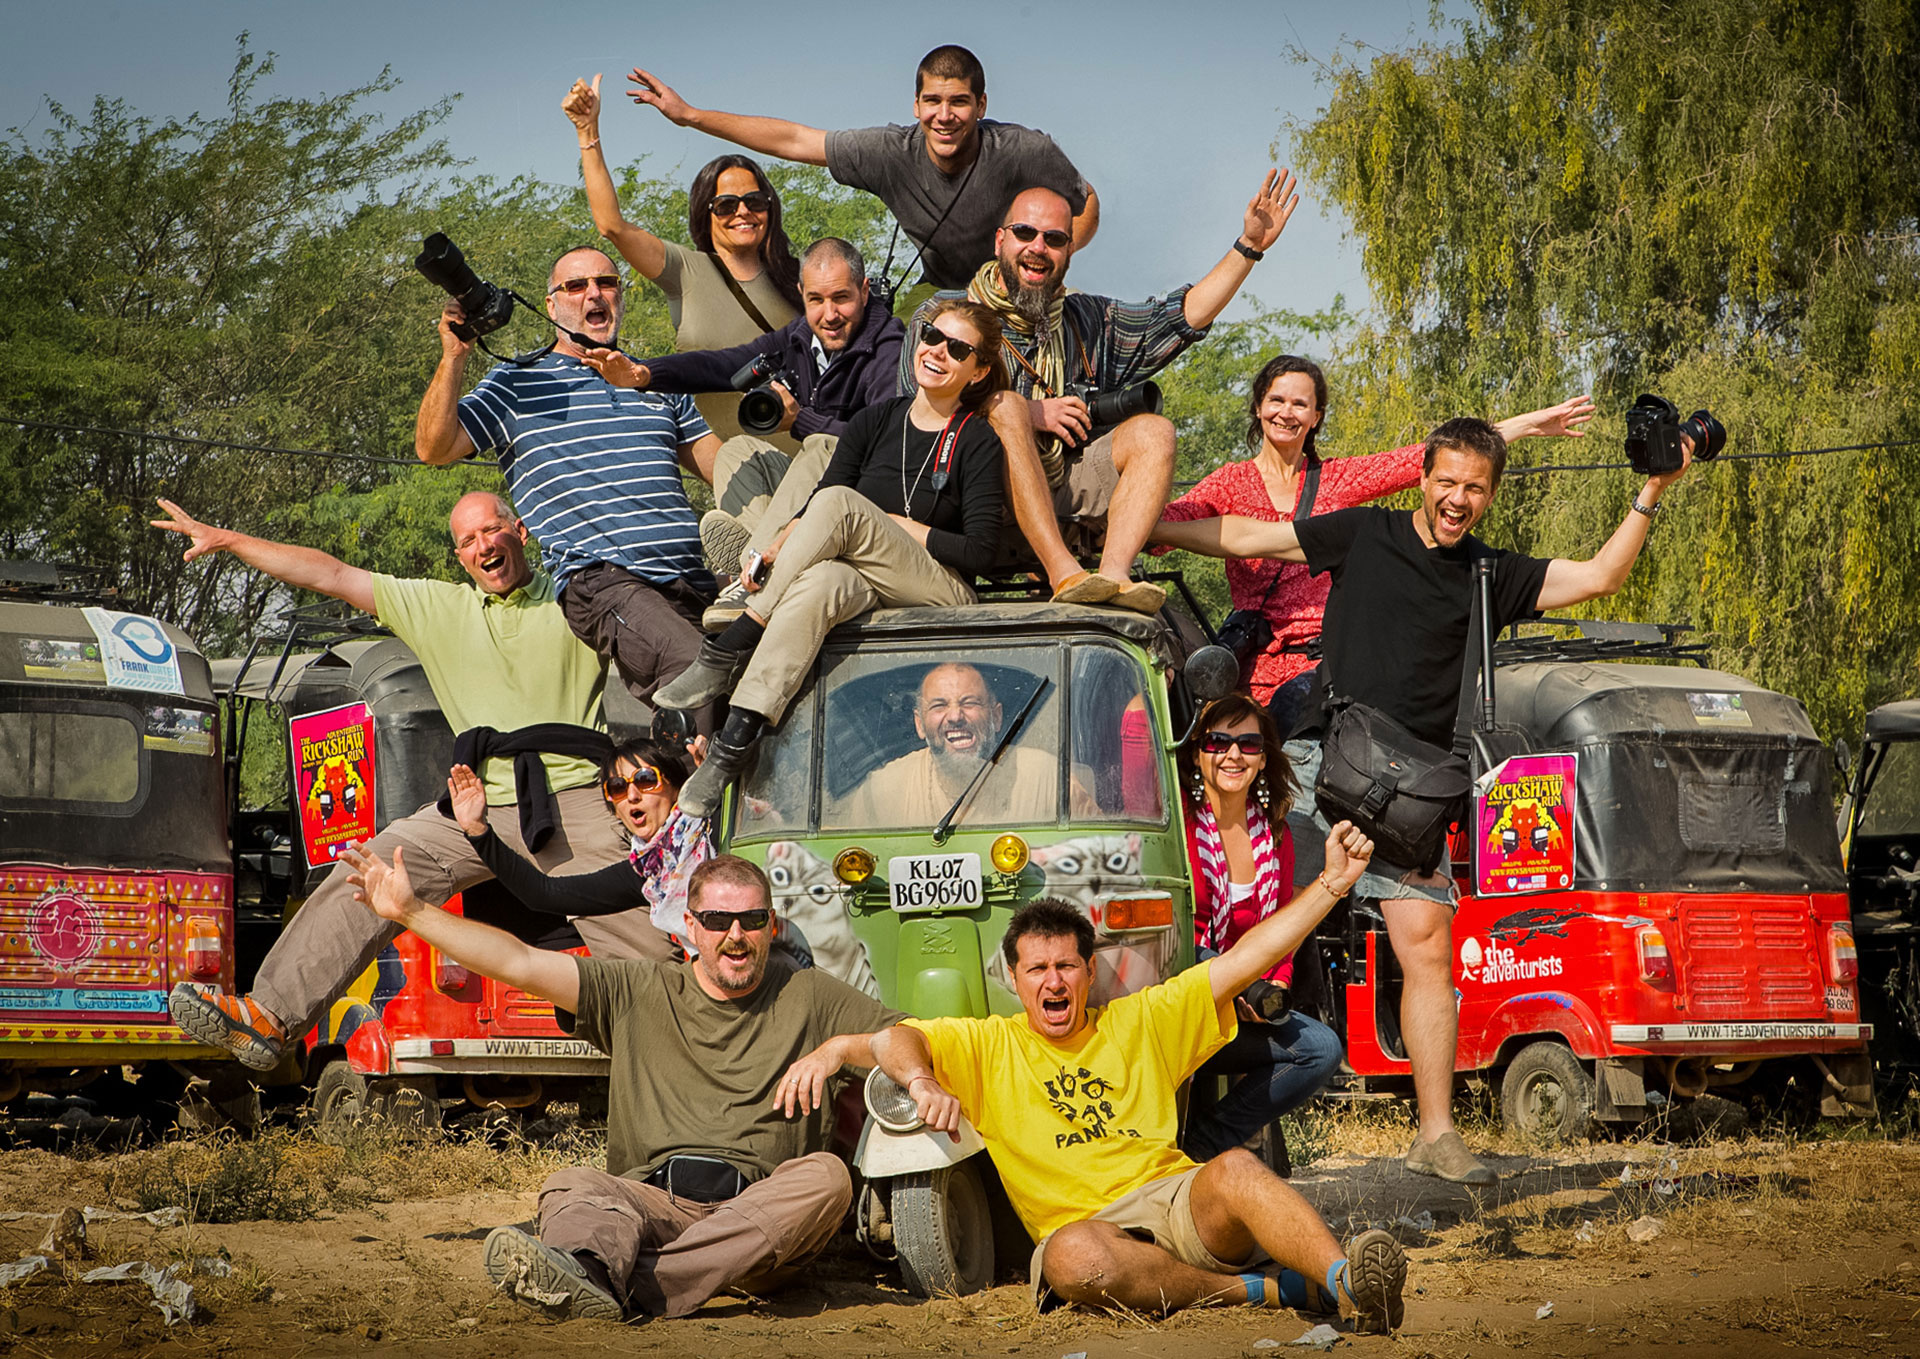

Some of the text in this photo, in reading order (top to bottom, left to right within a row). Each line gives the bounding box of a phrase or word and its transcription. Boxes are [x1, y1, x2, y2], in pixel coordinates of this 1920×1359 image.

[940, 431, 956, 463] Canon
[302, 731, 365, 763] RICKSHAW
[347, 748, 365, 763] RUN
[1540, 796, 1562, 807] RUN
[1484, 938, 1516, 967] the
[1482, 955, 1563, 985] adventurists
[74, 989, 153, 1009] CAMELS
[1687, 1025, 1836, 1039] WWW.THEADVENTURISTS.COM
[485, 1040, 602, 1056] WWW.THEADVE
